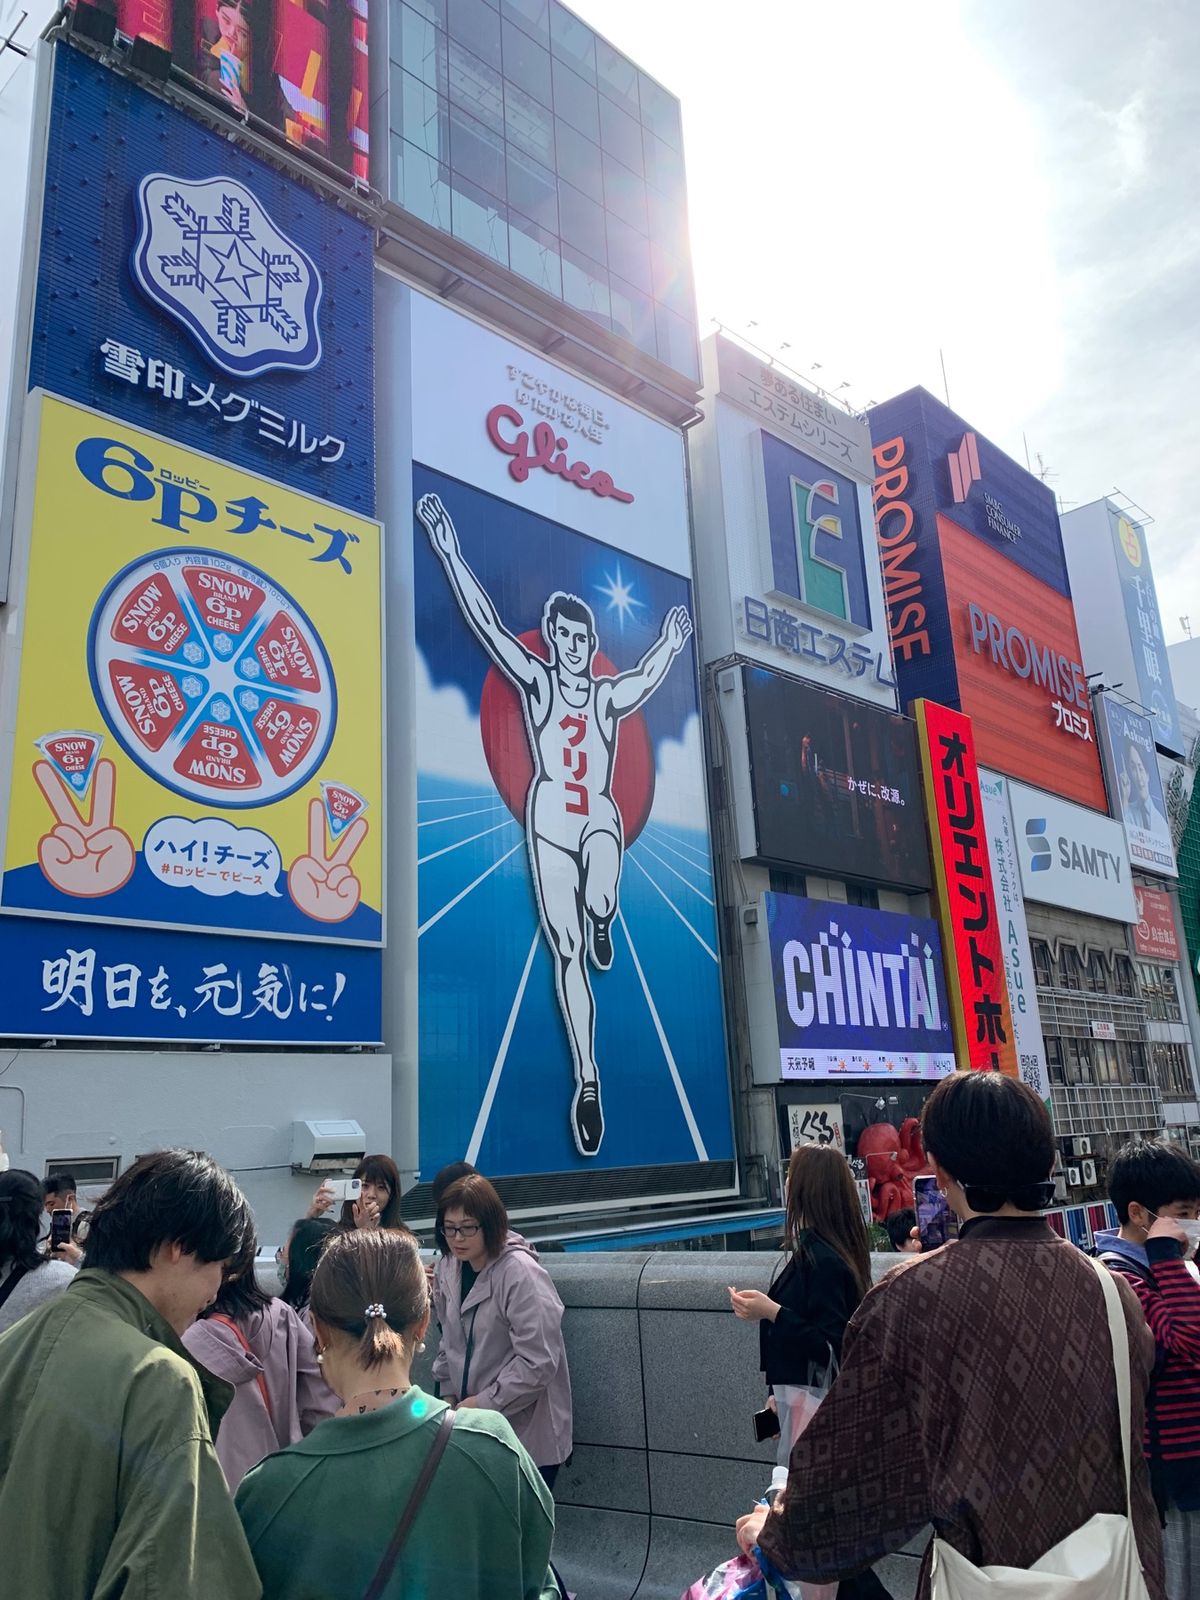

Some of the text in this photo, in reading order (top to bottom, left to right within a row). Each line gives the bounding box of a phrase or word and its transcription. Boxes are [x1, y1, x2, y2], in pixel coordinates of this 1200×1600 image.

[100, 337, 345, 463] 雪印メグミルク
[749, 387, 852, 462] エステムシリーズ
[485, 403, 635, 504] Glico
[160, 468, 210, 491] ロッピー
[985, 505, 1022, 538] CONSUMER
[988, 517, 1017, 544] FINANCE
[872, 436, 931, 660] PROMISE
[198, 572, 253, 601] SNOW
[213, 592, 237, 603] BRAND
[122, 582, 163, 634] SNOW
[144, 606, 161, 627] BRAND
[206, 596, 241, 621] 6P
[148, 612, 177, 641] 6P
[164, 623, 188, 651] CHEESE
[207, 616, 240, 632] CHEESE
[1129, 574, 1162, 687] 千里眼
[281, 626, 315, 679] SNOW
[282, 644, 296, 668] BRAND
[745, 596, 898, 688] 日商エステム
[968, 601, 1088, 711] PROMISE
[257, 645, 278, 680] CHEESE
[269, 640, 288, 676] 6P
[116, 675, 157, 735] SNOW
[140, 688, 155, 715] BRAND
[149, 678, 171, 718] 6P
[162, 675, 184, 711] CHEESE
[256, 701, 277, 729] CHEESE
[267, 710, 291, 739] 6P
[1051, 701, 1093, 743] プロミス
[55, 741, 87, 752] SNOW
[201, 735, 238, 759] 6P
[204, 725, 237, 739] CHEESE
[279, 717, 312, 768] SNOW
[280, 723, 295, 745] BRAND
[188, 759, 246, 783] SNOW
[206, 755, 231, 765] BRAND
[558, 713, 590, 816] グリコ
[333, 790, 356, 806] SNOW
[847, 776, 906, 807] かぜに、改源。
[161, 864, 263, 885] #ロッピーでピース
[1058, 836, 1122, 886] SAMTY
[994, 837, 1026, 1014] 株式会社 Asue
[782, 922, 941, 1031] CHINTAI
[787, 1057, 815, 1071] 天気予報
